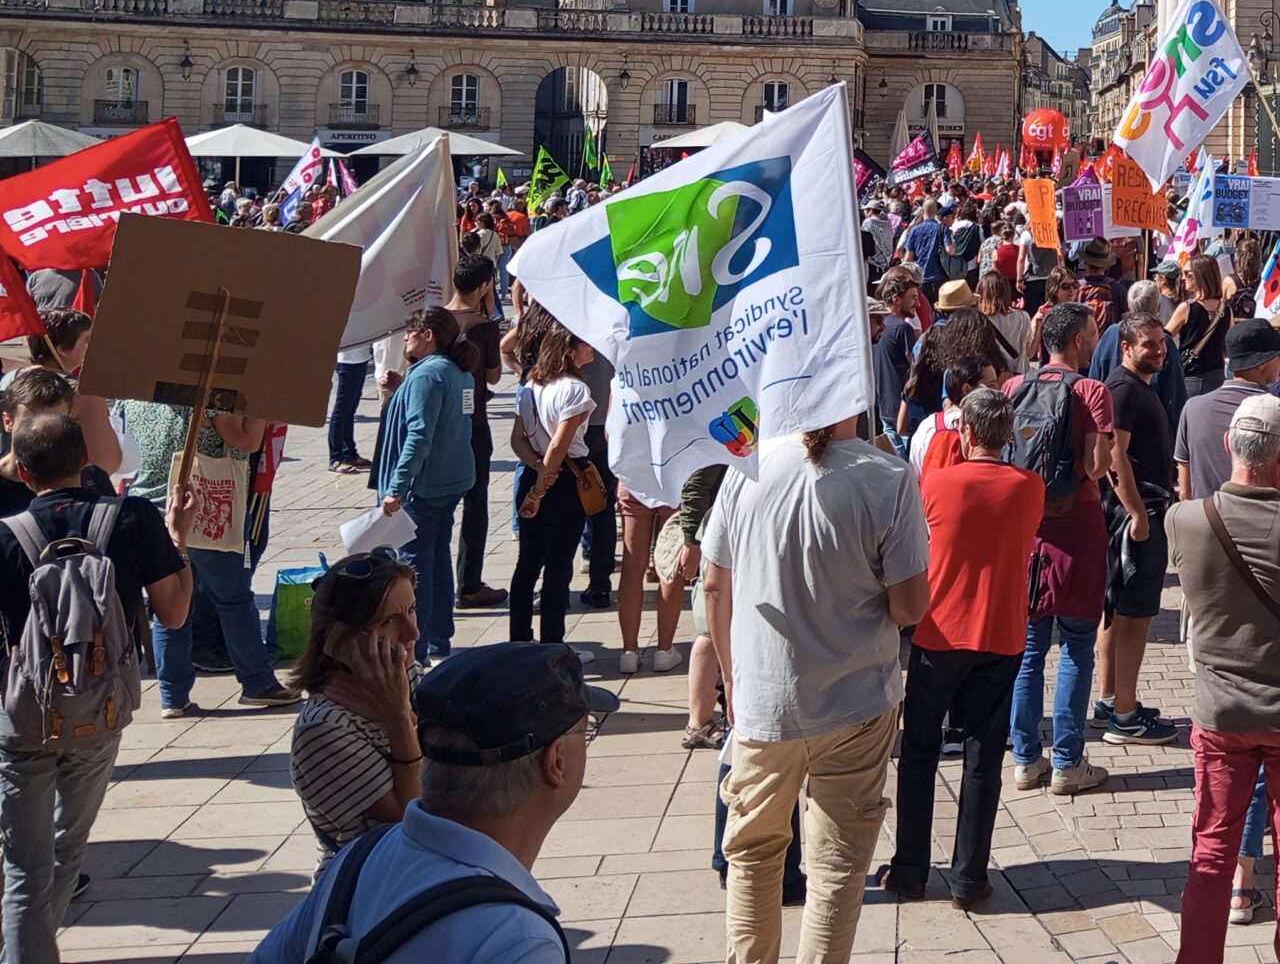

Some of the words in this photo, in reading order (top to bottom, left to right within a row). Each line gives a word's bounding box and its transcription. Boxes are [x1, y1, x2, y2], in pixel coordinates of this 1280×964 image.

[1028, 123, 1054, 141] cgt
[1228, 178, 1250, 190] VRAI
[1078, 189, 1101, 201] VRAI
